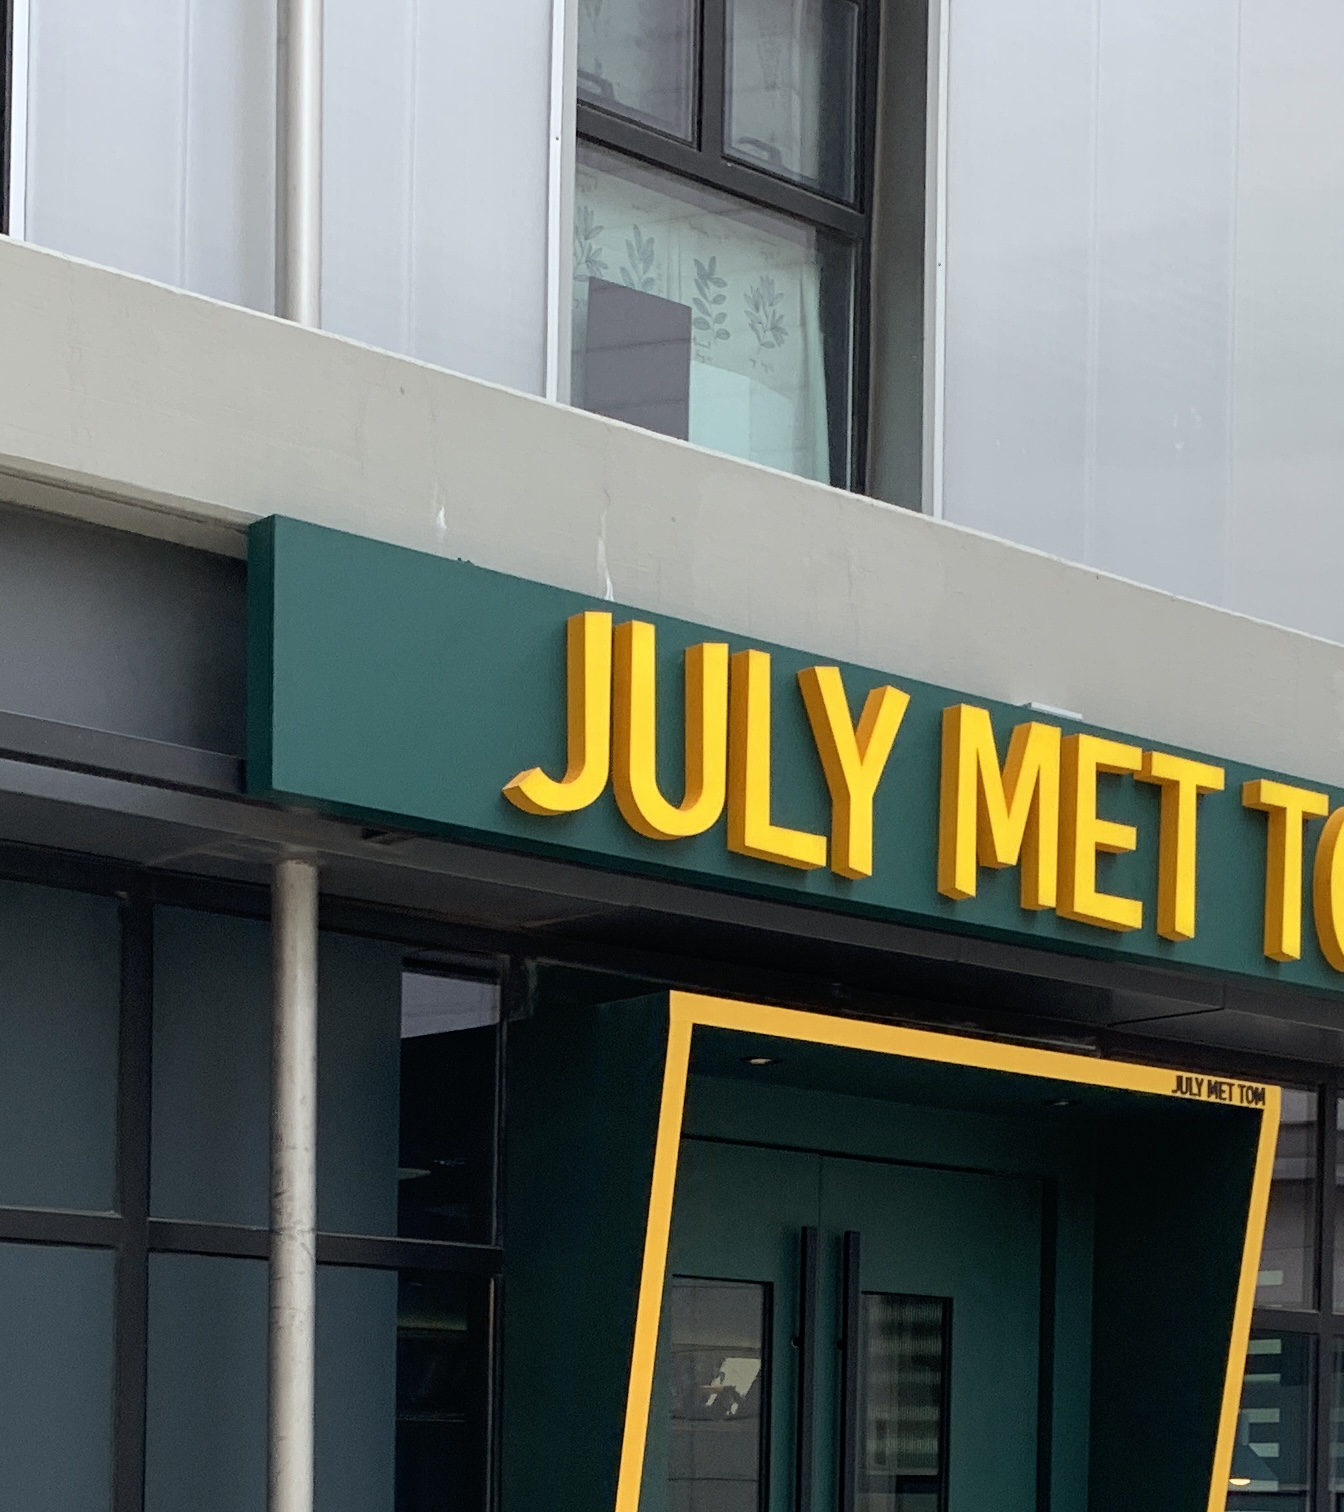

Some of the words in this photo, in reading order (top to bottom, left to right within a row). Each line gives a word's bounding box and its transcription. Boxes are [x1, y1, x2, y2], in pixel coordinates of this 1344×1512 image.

[502, 609, 910, 881] JULY
[937, 702, 1224, 941] MET
[1171, 1075, 1203, 1097] JULY
[1207, 1079, 1235, 1101] MET
[1237, 1083, 1266, 1105] TOM
